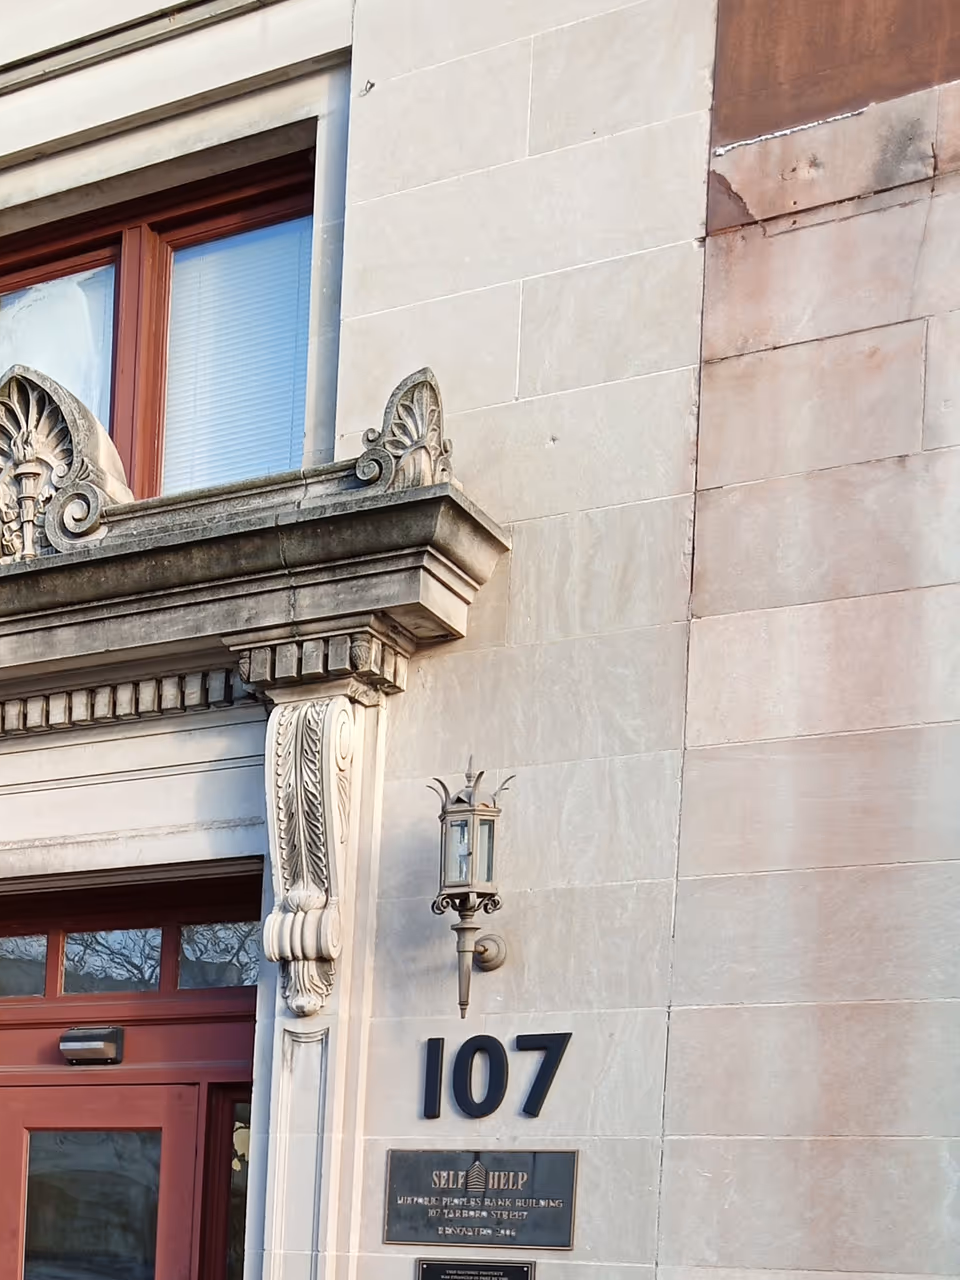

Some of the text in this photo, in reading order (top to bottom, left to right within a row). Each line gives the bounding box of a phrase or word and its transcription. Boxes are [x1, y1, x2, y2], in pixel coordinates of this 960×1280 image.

[424, 1032, 572, 1119] 107
[431, 1171, 528, 1190] SELF HELP
[484, 1198, 512, 1207] BANK
[515, 1198, 563, 1208] BUILDING
[428, 1208, 441, 1217] 107
[491, 1210, 528, 1219] STREET
